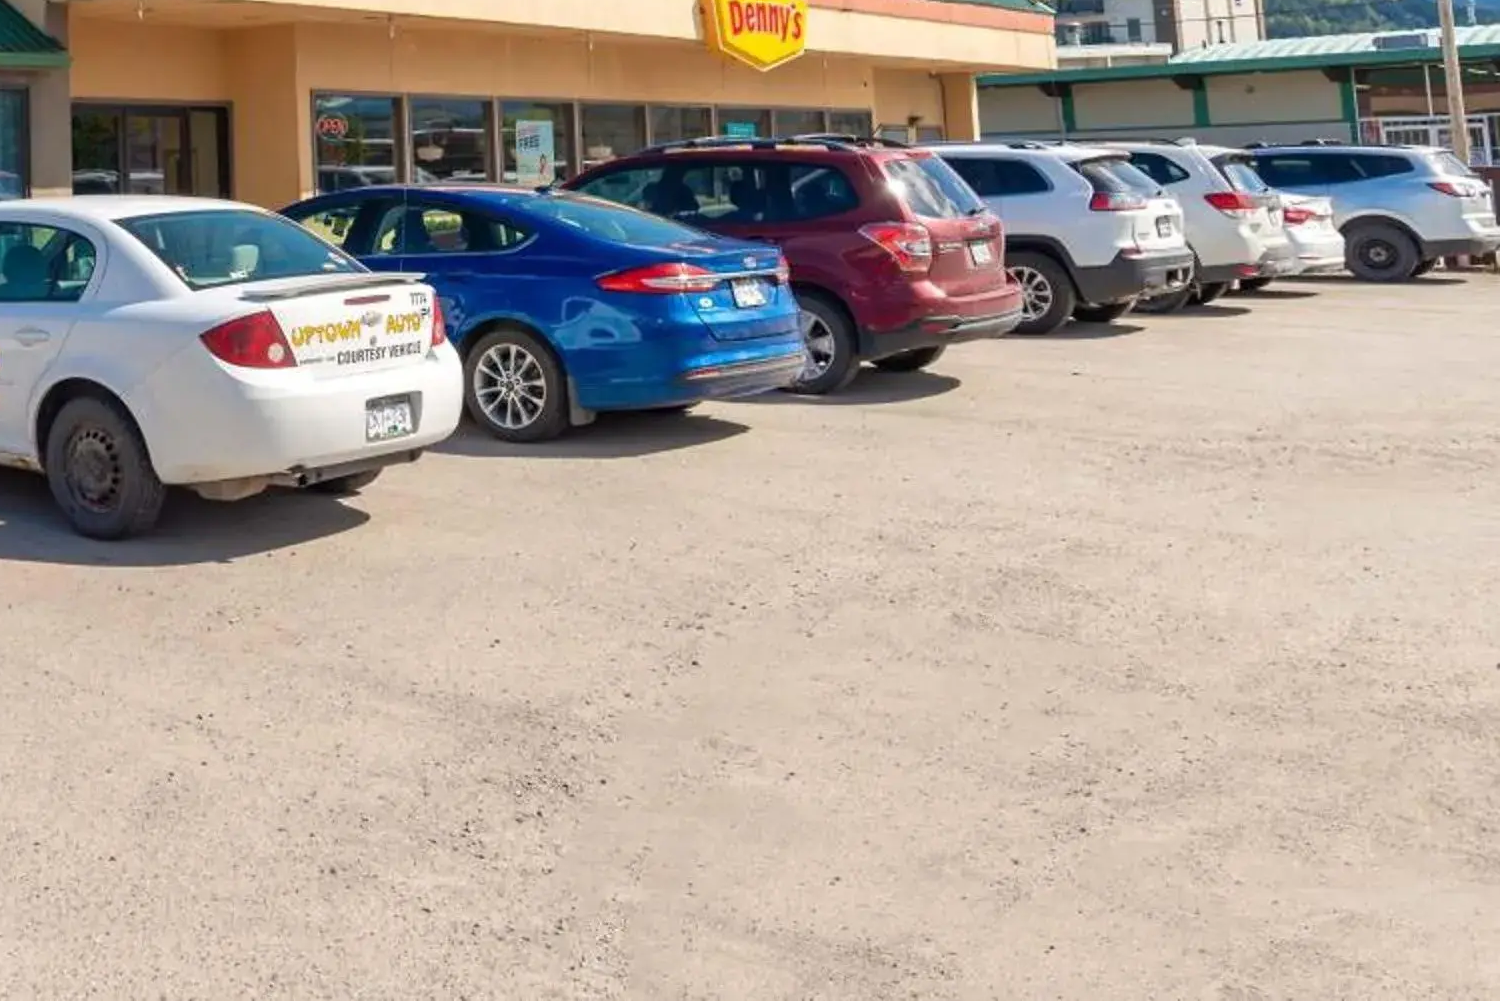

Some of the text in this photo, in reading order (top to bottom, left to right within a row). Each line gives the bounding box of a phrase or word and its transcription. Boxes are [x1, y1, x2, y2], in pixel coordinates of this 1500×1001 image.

[728, 0, 802, 42] Denny's
[291, 311, 421, 347] UPTOWN AUTO
[337, 345, 386, 365] COURTESY
